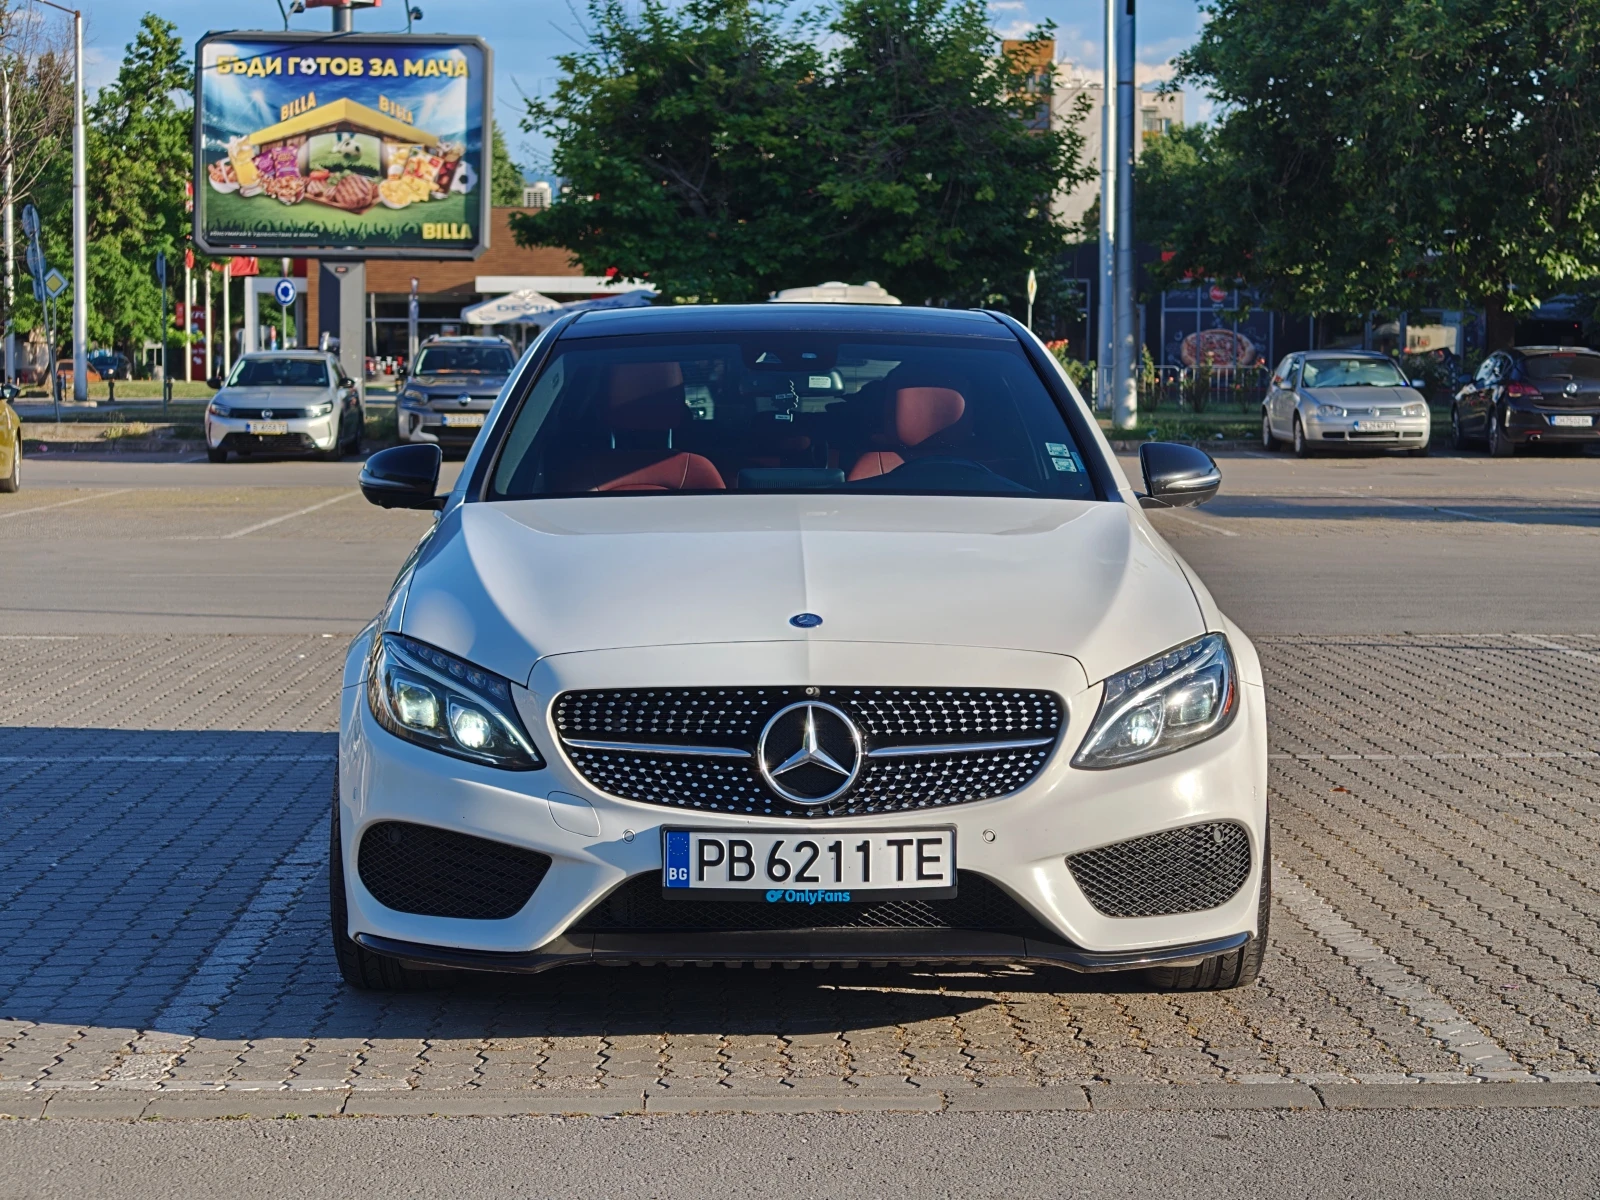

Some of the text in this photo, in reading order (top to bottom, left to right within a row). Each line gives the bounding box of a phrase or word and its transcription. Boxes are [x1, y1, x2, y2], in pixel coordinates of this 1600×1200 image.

[216, 55, 469, 78] БЪДИ ГОТОВ ЗА МАЧА
[280, 91, 316, 121] BILLA
[378, 94, 414, 125] BILLA
[422, 222, 473, 240] BILLA
[496, 302, 556, 315] DEVIN
[668, 837, 943, 883] BG PB 6211 TE
[784, 889, 850, 905] OnlyFans
